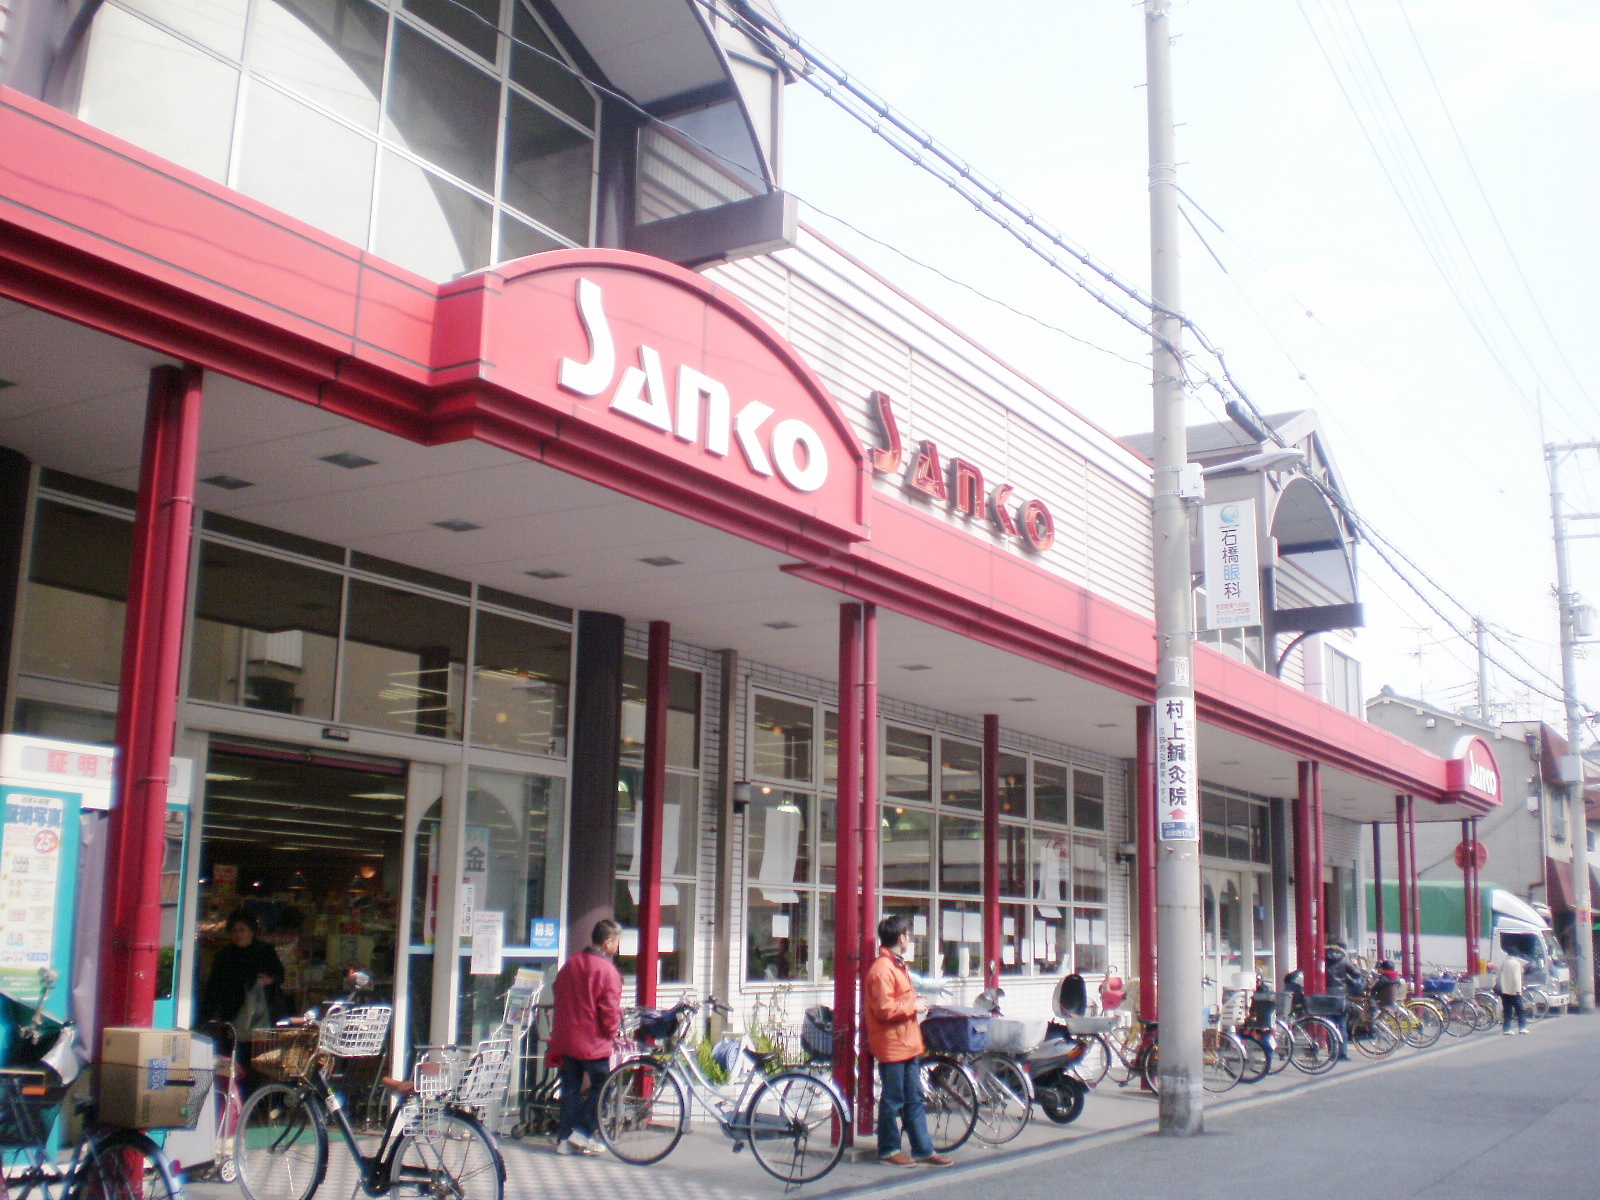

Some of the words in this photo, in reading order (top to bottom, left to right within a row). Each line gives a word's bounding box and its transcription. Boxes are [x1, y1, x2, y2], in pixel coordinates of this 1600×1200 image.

[557, 277, 829, 492] SANKO
[867, 390, 1055, 551] SANKO
[1221, 529, 1242, 599] 石橋眼科
[47, 750, 114, 779] 証明
[1166, 699, 1187, 807] 村上鍼灸院
